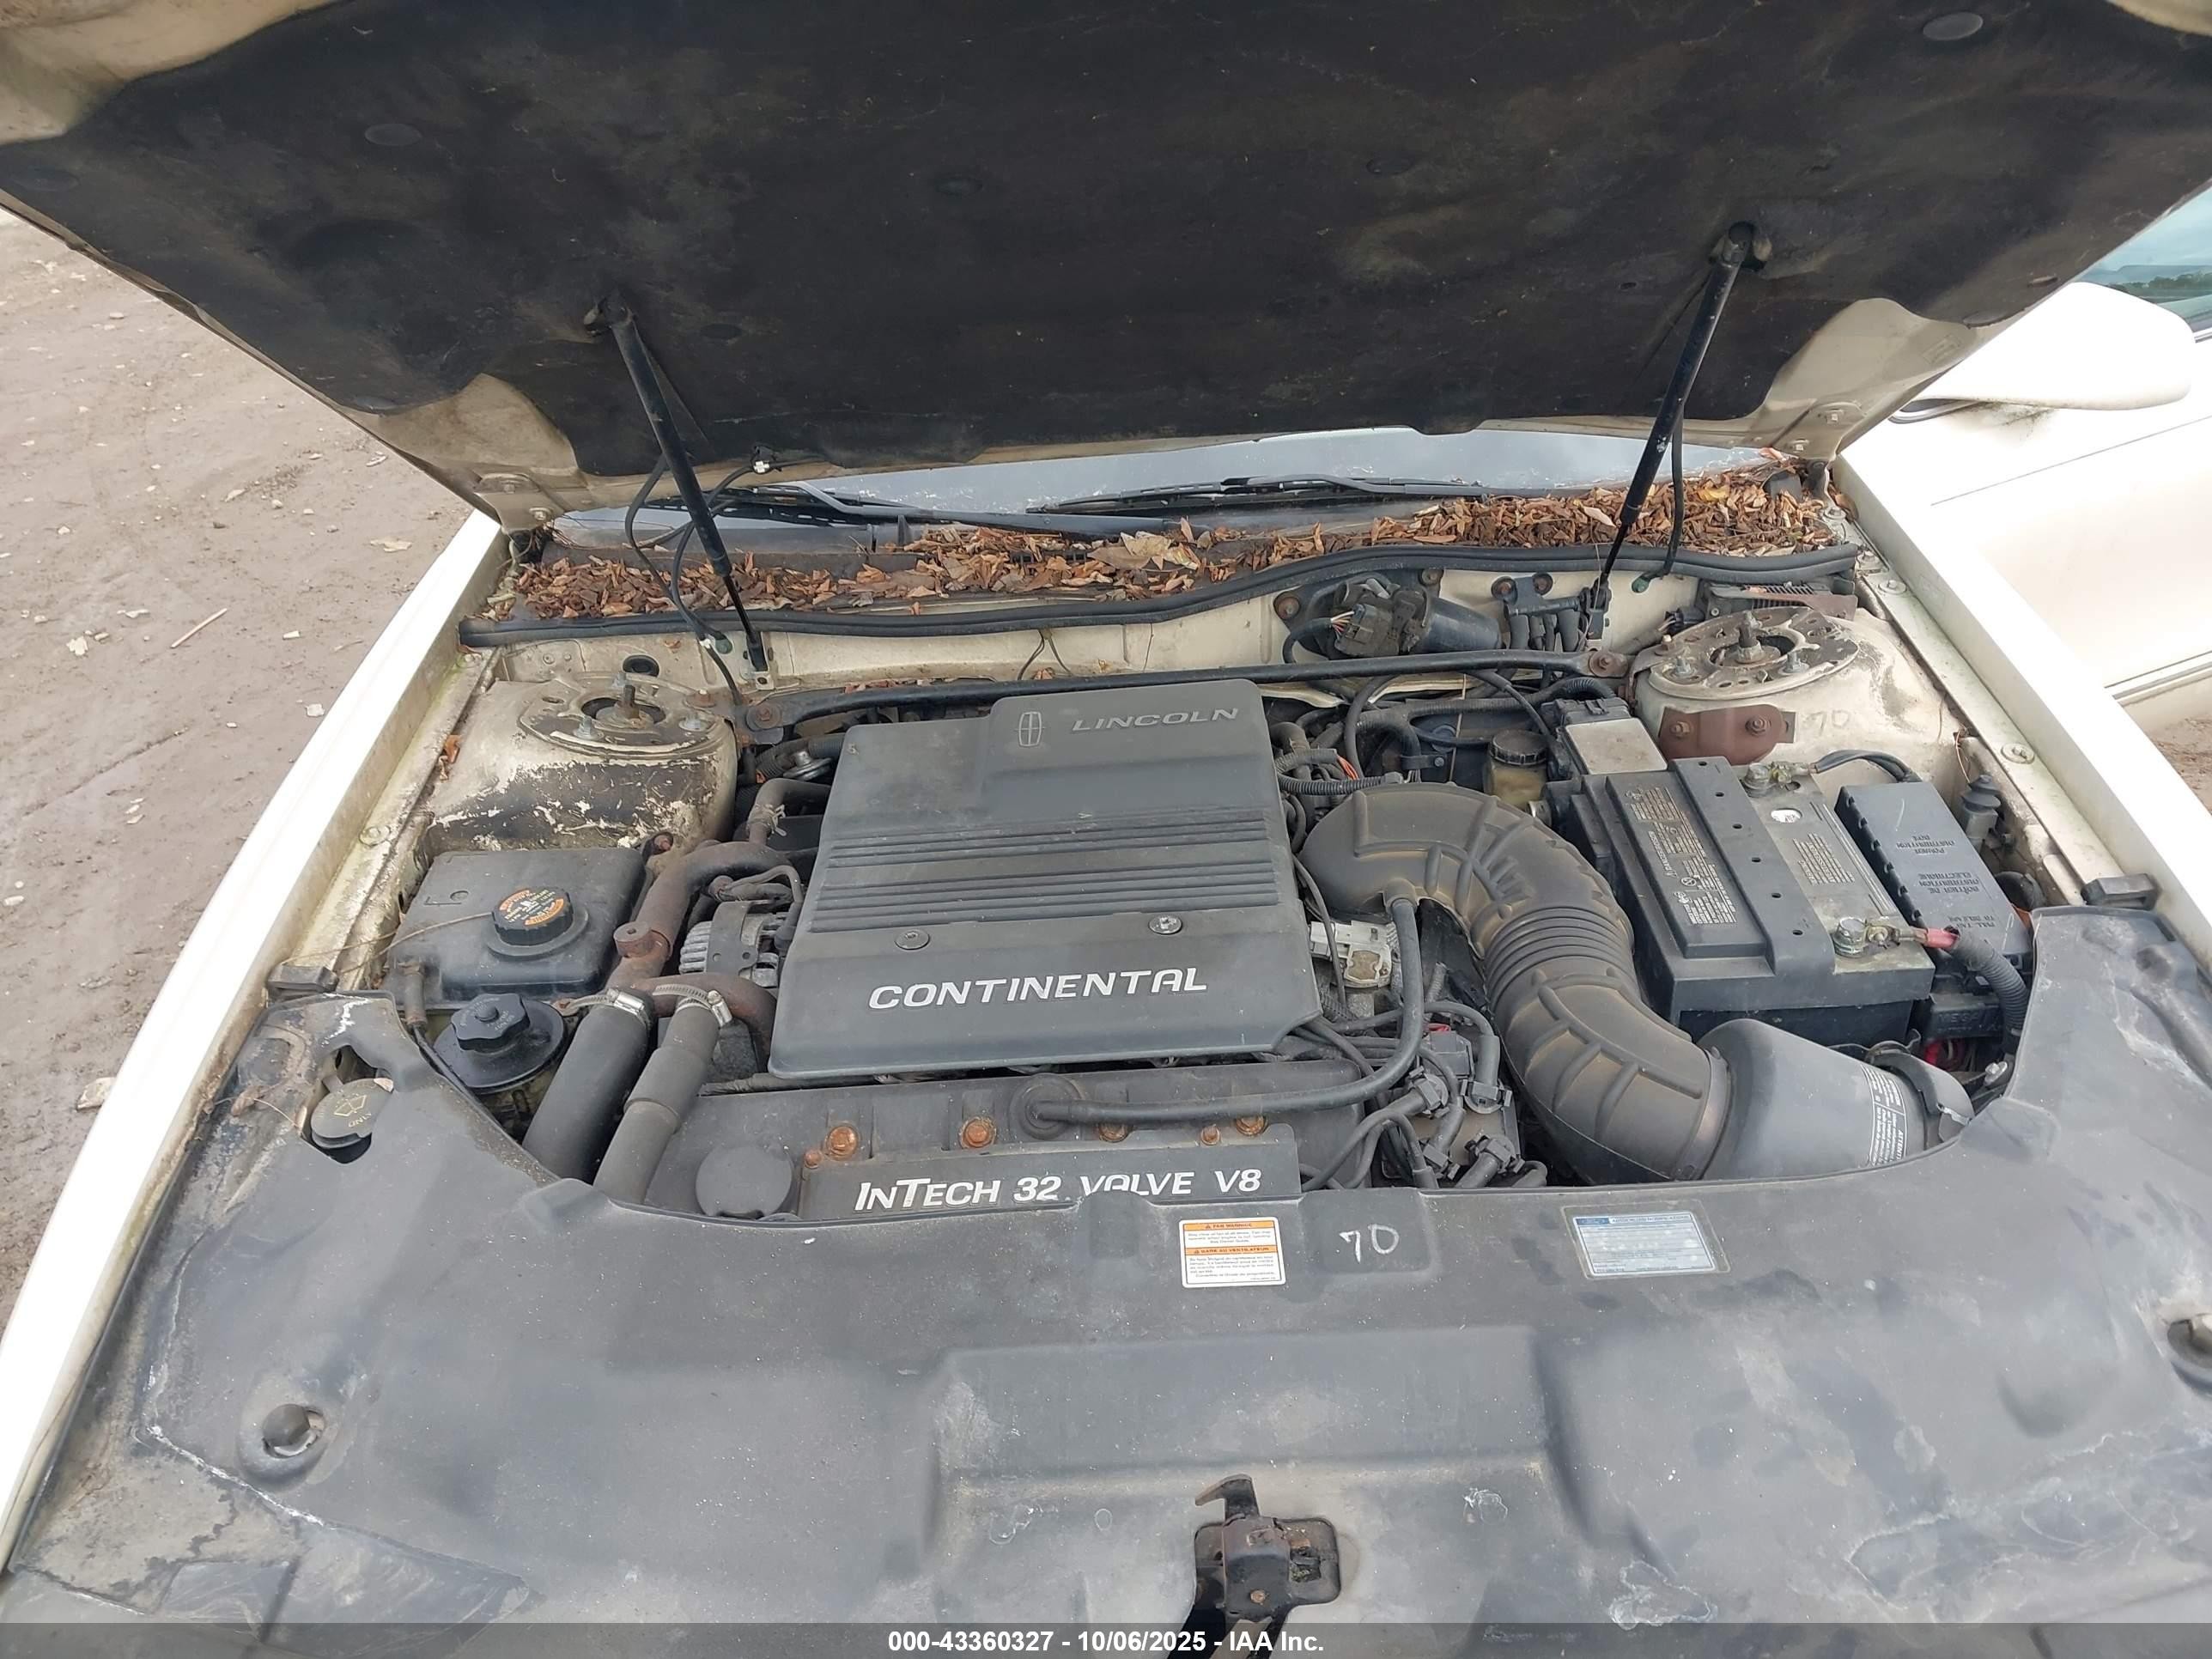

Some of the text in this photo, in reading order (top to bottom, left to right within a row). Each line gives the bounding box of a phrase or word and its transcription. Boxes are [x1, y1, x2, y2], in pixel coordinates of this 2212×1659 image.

[1073, 708, 1238, 732] LINCOLN
[868, 967, 1207, 1010] CONTINENTAL
[1013, 1176, 1062, 1201] 32
[1079, 1171, 1194, 1197] VALVE
[1214, 1169, 1262, 1194] V8
[1339, 1224, 1400, 1263] 70
